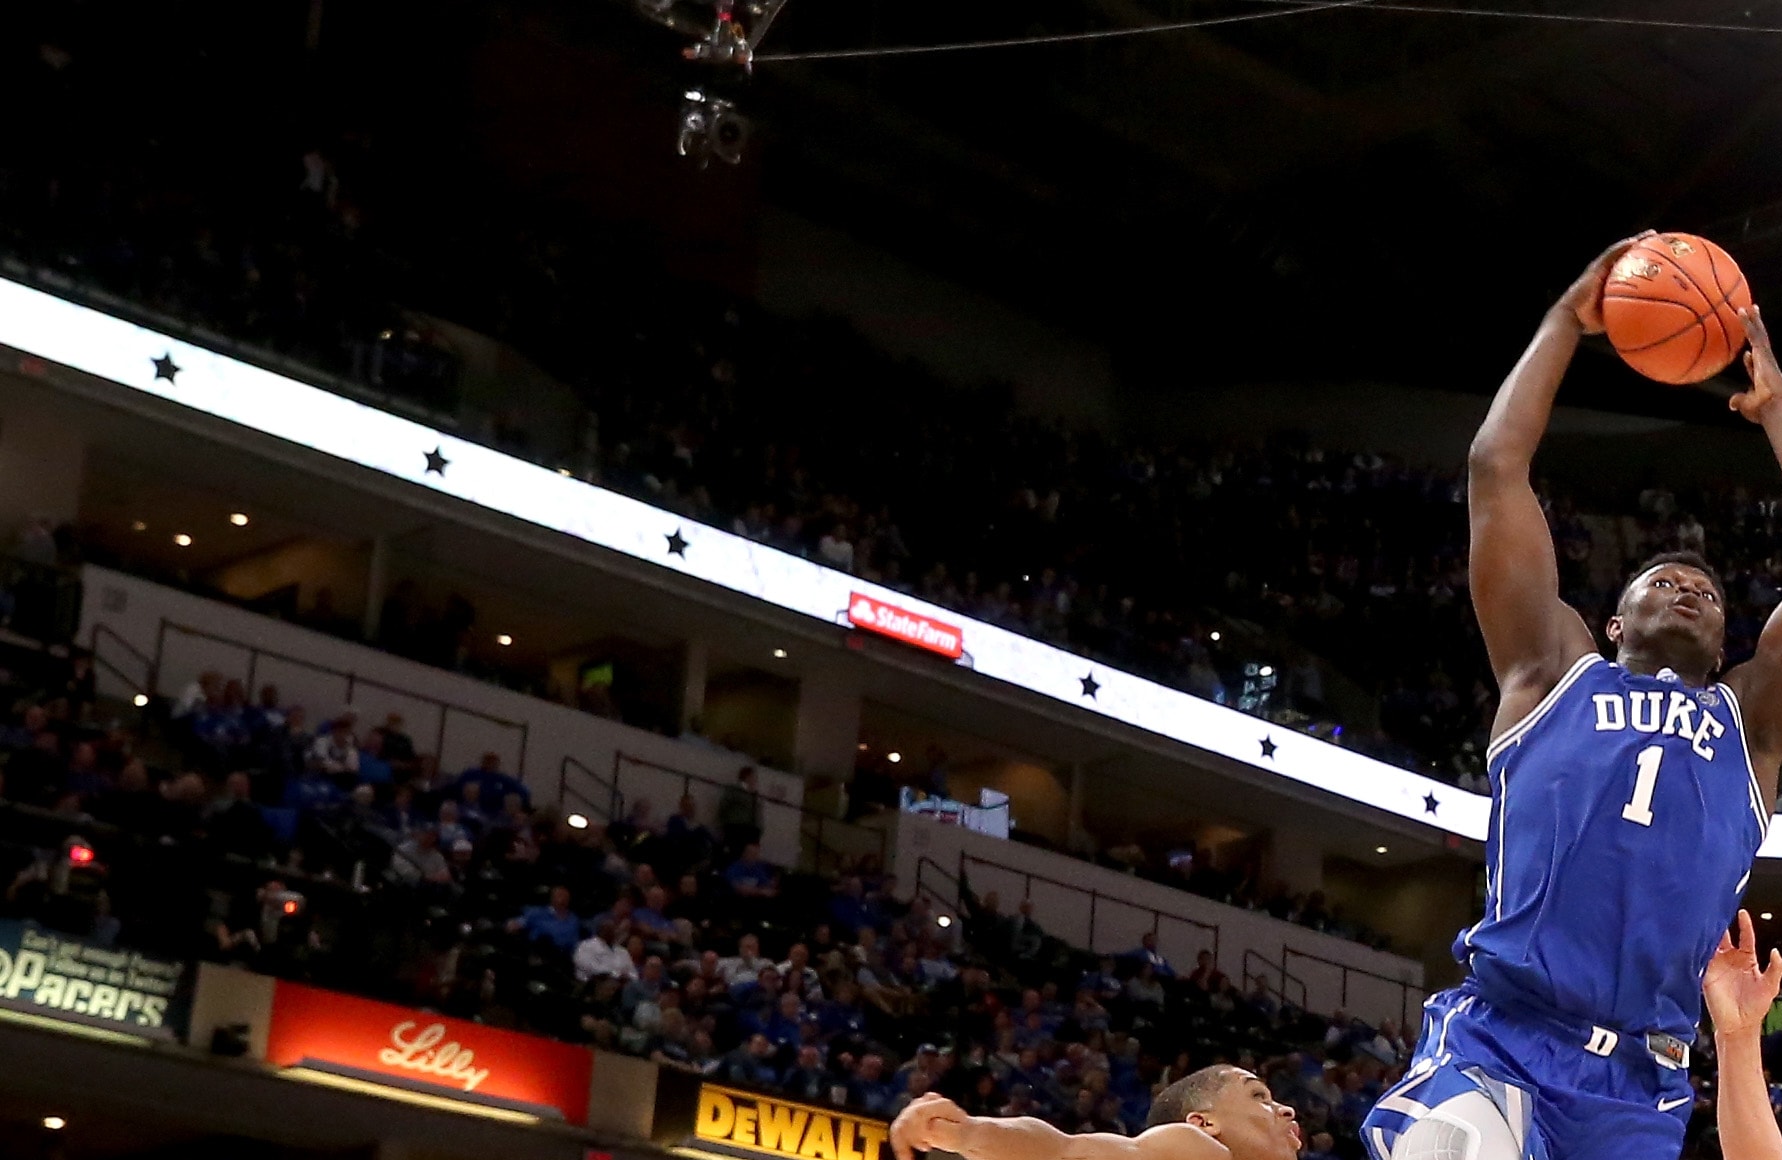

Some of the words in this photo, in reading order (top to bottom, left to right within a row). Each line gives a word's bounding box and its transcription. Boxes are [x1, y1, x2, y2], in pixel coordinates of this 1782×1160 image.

[1592, 690, 1725, 762] DUKE
[1621, 745, 1664, 827] 1
[380, 1020, 490, 1092] Lilly
